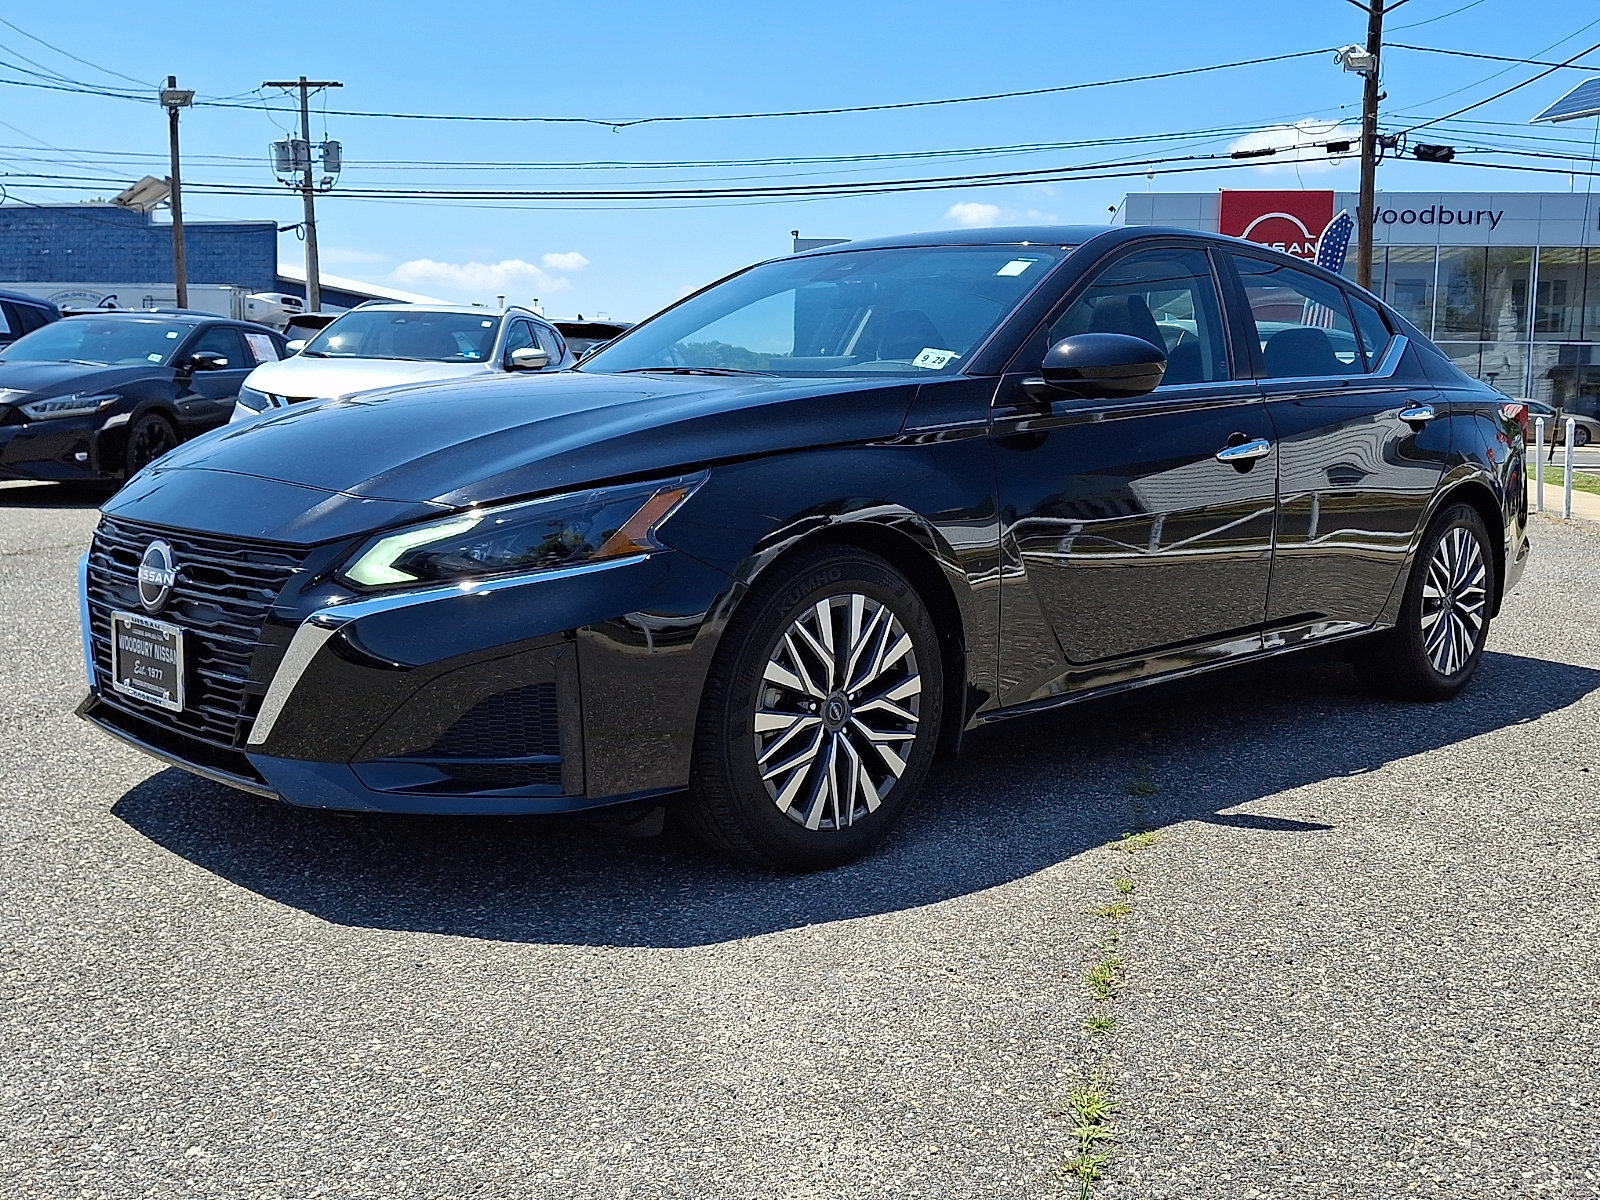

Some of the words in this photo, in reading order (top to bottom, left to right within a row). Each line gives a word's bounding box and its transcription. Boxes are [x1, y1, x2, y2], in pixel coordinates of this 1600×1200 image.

[1260, 242, 1318, 254] SAN
[921, 354, 930, 362] 9
[932, 356, 946, 364] 29
[139, 568, 173, 585] SSAN
[780, 568, 841, 615] KUMHO
[130, 617, 160, 629] NISSAN
[119, 634, 153, 658] WOODBURY
[133, 660, 146, 676] Est.
[147, 666, 162, 680] 1977
